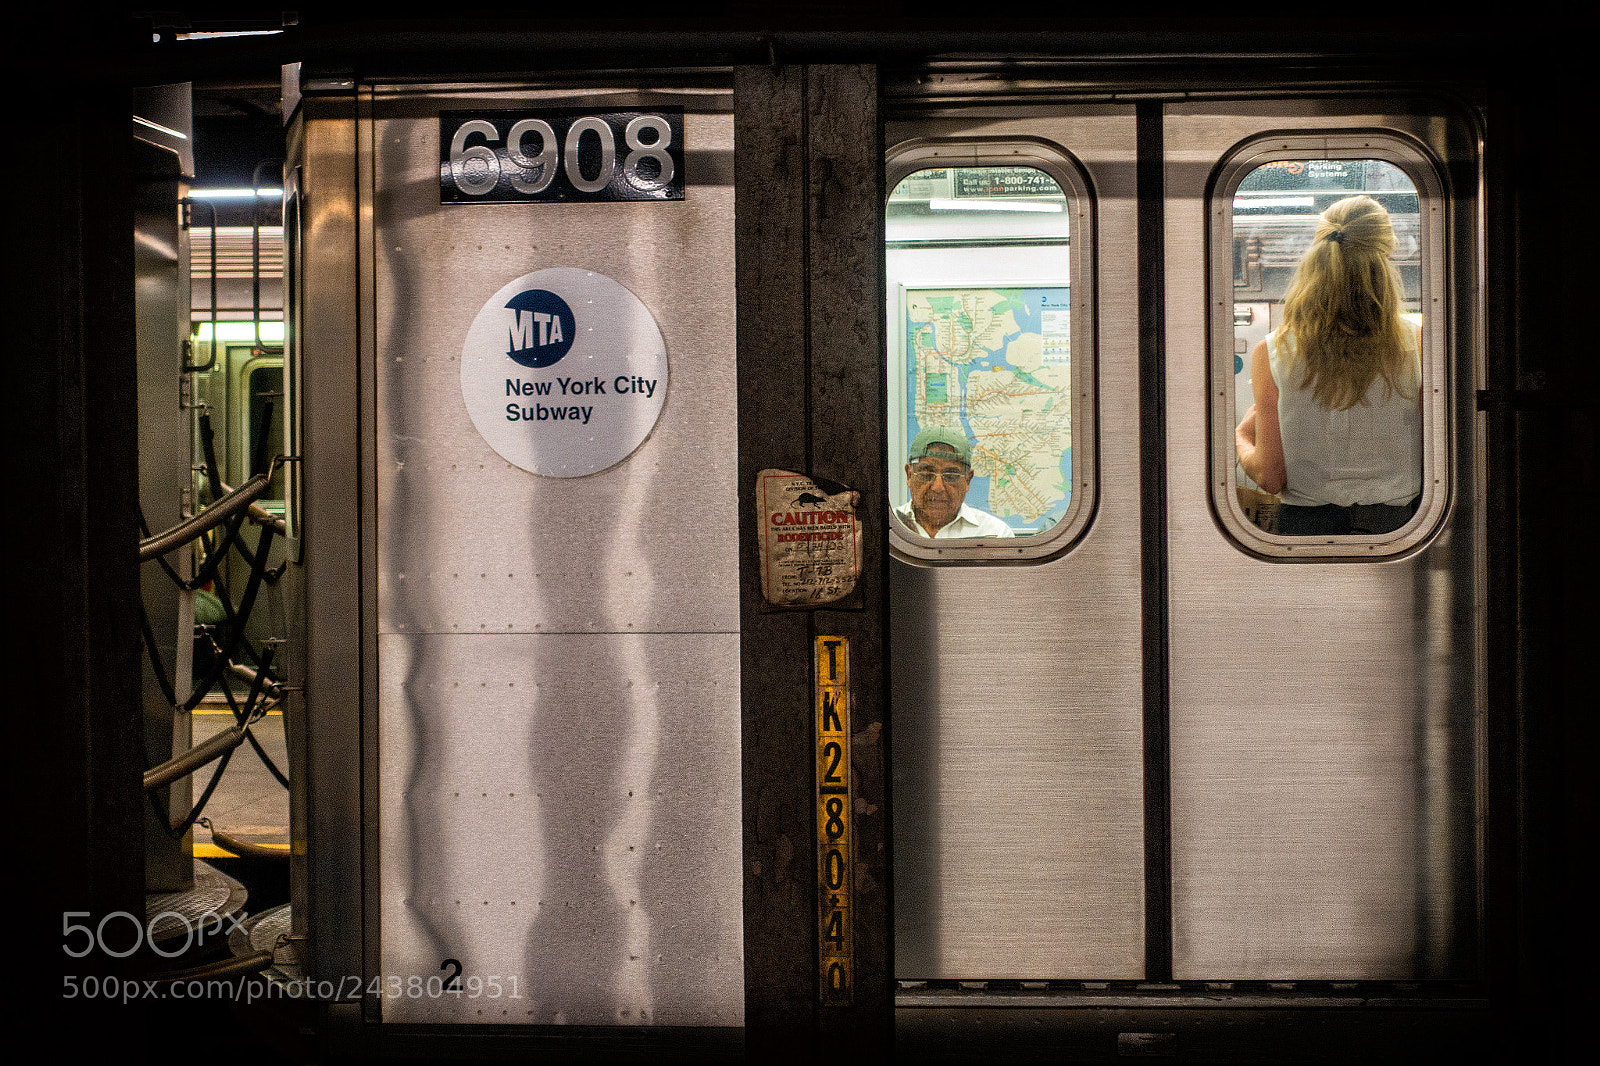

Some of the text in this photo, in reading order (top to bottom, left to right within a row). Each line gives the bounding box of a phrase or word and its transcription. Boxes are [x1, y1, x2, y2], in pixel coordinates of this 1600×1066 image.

[450, 115, 675, 195] 6908
[1308, 163, 1342, 171] Parking
[963, 178, 977, 186] Call
[963, 185, 1058, 193] www.iconparking.com
[504, 307, 564, 352] MTA
[505, 375, 658, 399] New York City
[505, 403, 593, 424] Subway
[771, 511, 848, 526] CAUTION
[777, 531, 843, 542] RODENTICIDE
[440, 958, 464, 991] 2
